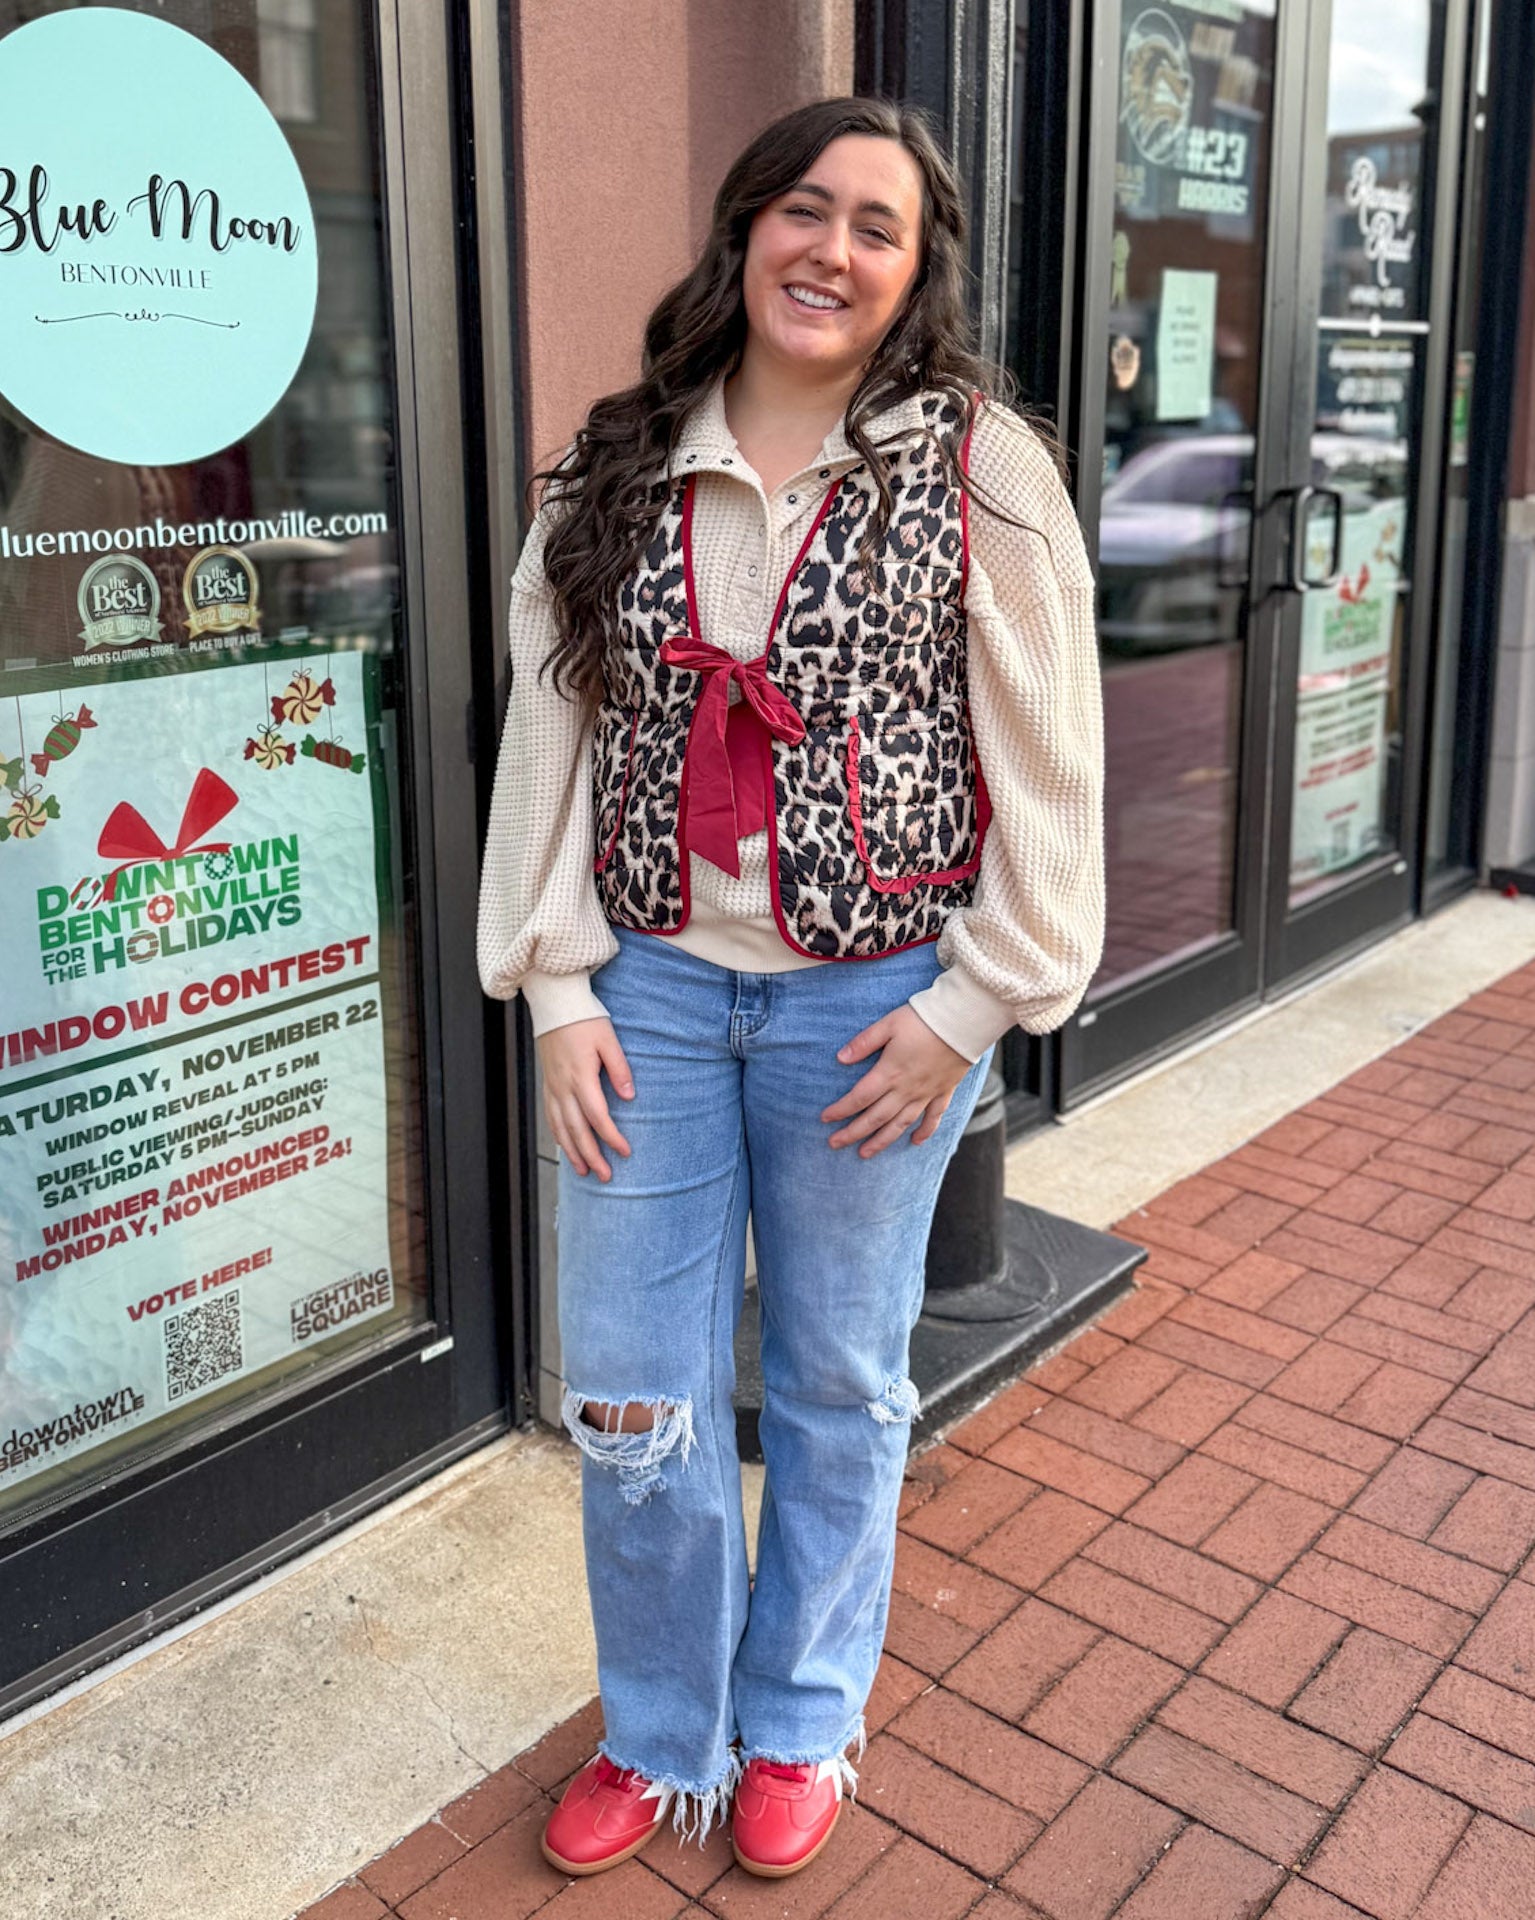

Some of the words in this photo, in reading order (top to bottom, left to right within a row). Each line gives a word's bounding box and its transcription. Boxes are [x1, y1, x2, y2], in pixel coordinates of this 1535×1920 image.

[127, 174, 300, 252] Moon
[60, 262, 214, 290] BENTONVILLE
[91, 582, 148, 613] Best
[109, 575, 128, 589] the
[196, 571, 247, 600] Best
[212, 565, 230, 579] the
[73, 653, 112, 667] WOMEN'S
[112, 648, 149, 663] CLOTHING
[150, 644, 175, 658] STORE
[189, 640, 213, 653] PLACE
[214, 638, 223, 650] TO
[37, 834, 299, 920] DOWNTOWN
[38, 866, 300, 951] BENTONVILLE
[42, 946, 85, 970] FOR
[92, 895, 301, 974] HOLIDAYS
[0, 992, 169, 1070] INDOW
[180, 935, 370, 1016] CONTEST
[43, 963, 88, 985] THE
[182, 1011, 340, 1080] NOVEMBER
[346, 999, 378, 1027] 22
[37, 1149, 125, 1192] PUBLIC
[129, 1078, 328, 1158] VIEWING/JUDGING:
[45, 1110, 148, 1157] WINDOW
[152, 1081, 238, 1121] REVEAL
[243, 1068, 271, 1090] AT
[276, 1062, 287, 1078] 5
[292, 1051, 320, 1073] PM
[16, 1215, 158, 1282] MONDAY,
[163, 1153, 309, 1227] NOVEMBER
[314, 1137, 352, 1167] 24!
[42, 1188, 160, 1246] WINNER
[166, 1125, 330, 1201] ANNOUNCED
[43, 1148, 176, 1209] SATURDAY
[180, 1142, 193, 1160] 5
[126, 1280, 198, 1322] VOTE
[201, 1247, 273, 1295] HERE!
[291, 1268, 389, 1324] LIGHTING
[296, 1285, 391, 1340] SQUARE
[0, 1394, 144, 1473] BENTONVILLE
[2, 1386, 135, 1456] downtown
